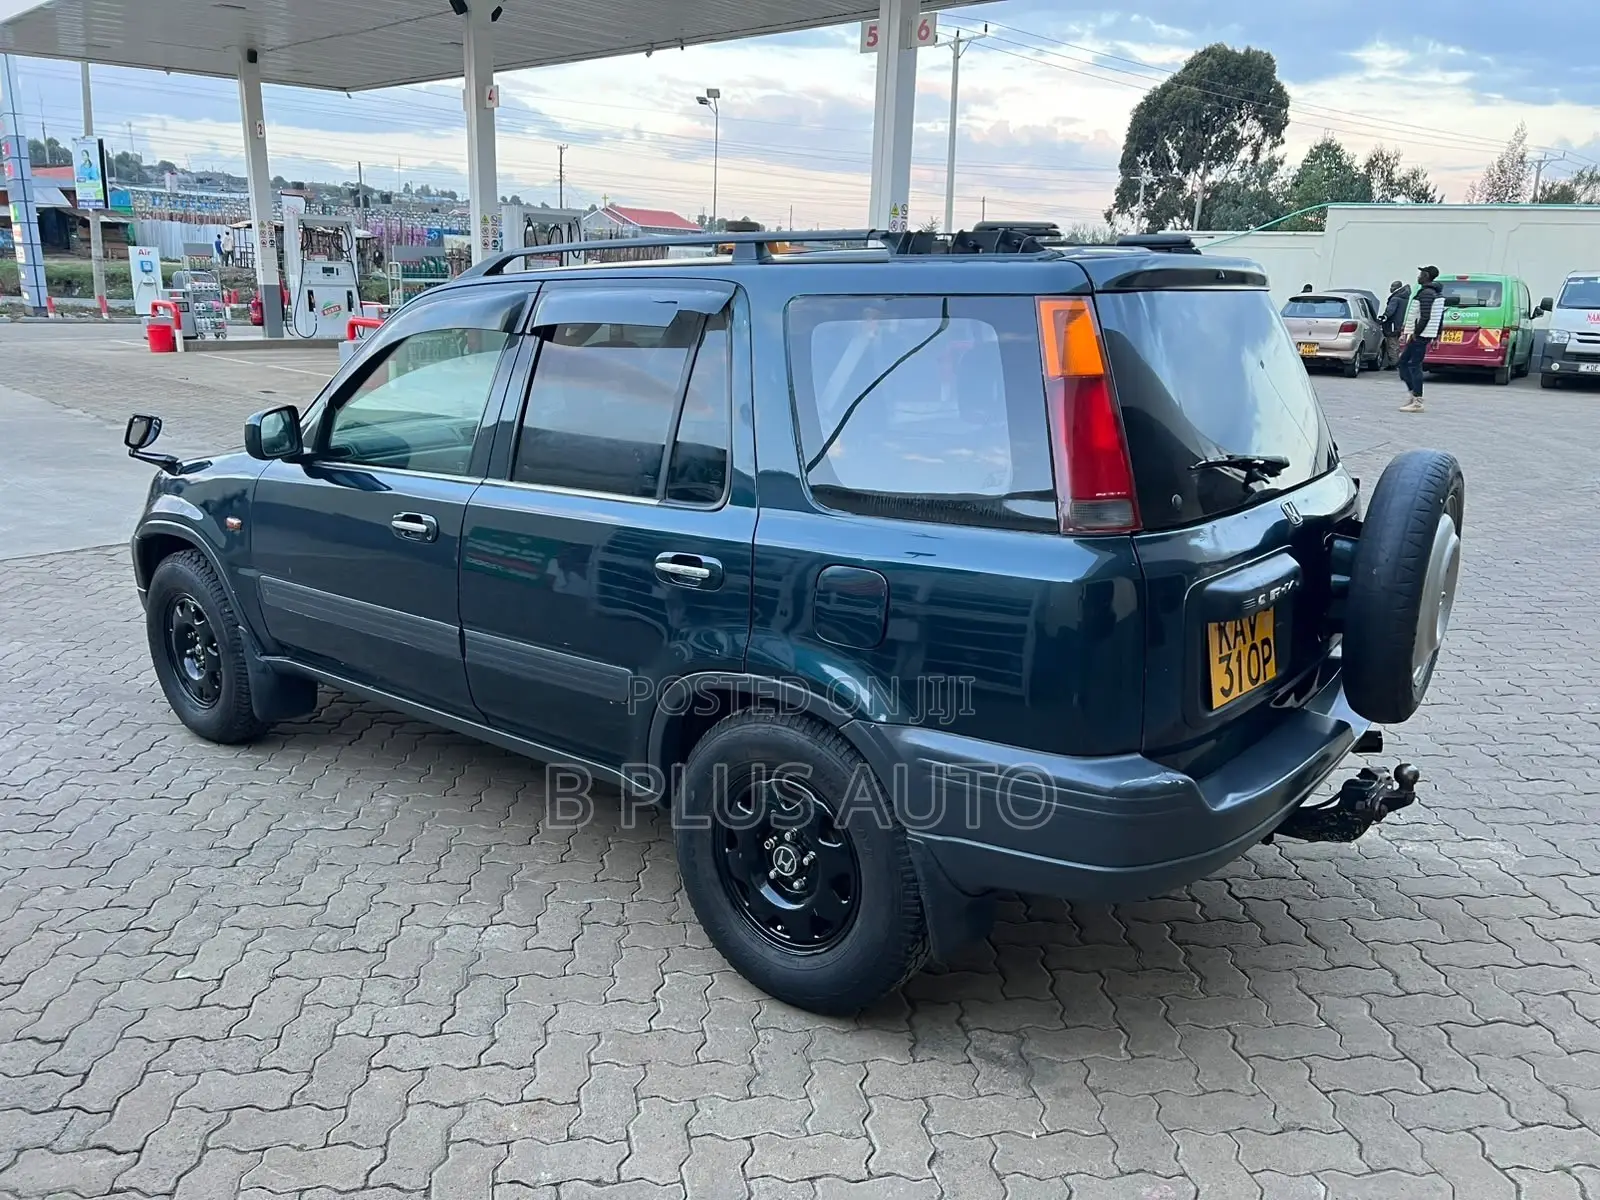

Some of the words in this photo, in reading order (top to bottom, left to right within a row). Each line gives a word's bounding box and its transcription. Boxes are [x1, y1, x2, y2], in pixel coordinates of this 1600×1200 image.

[866, 25, 879, 47] 5
[917, 18, 931, 41] 6
[488, 88, 496, 103] 4
[257, 123, 263, 136] 2
[138, 248, 152, 256] Air
[1216, 614, 1258, 655] KAV
[1218, 637, 1273, 698] 310P
